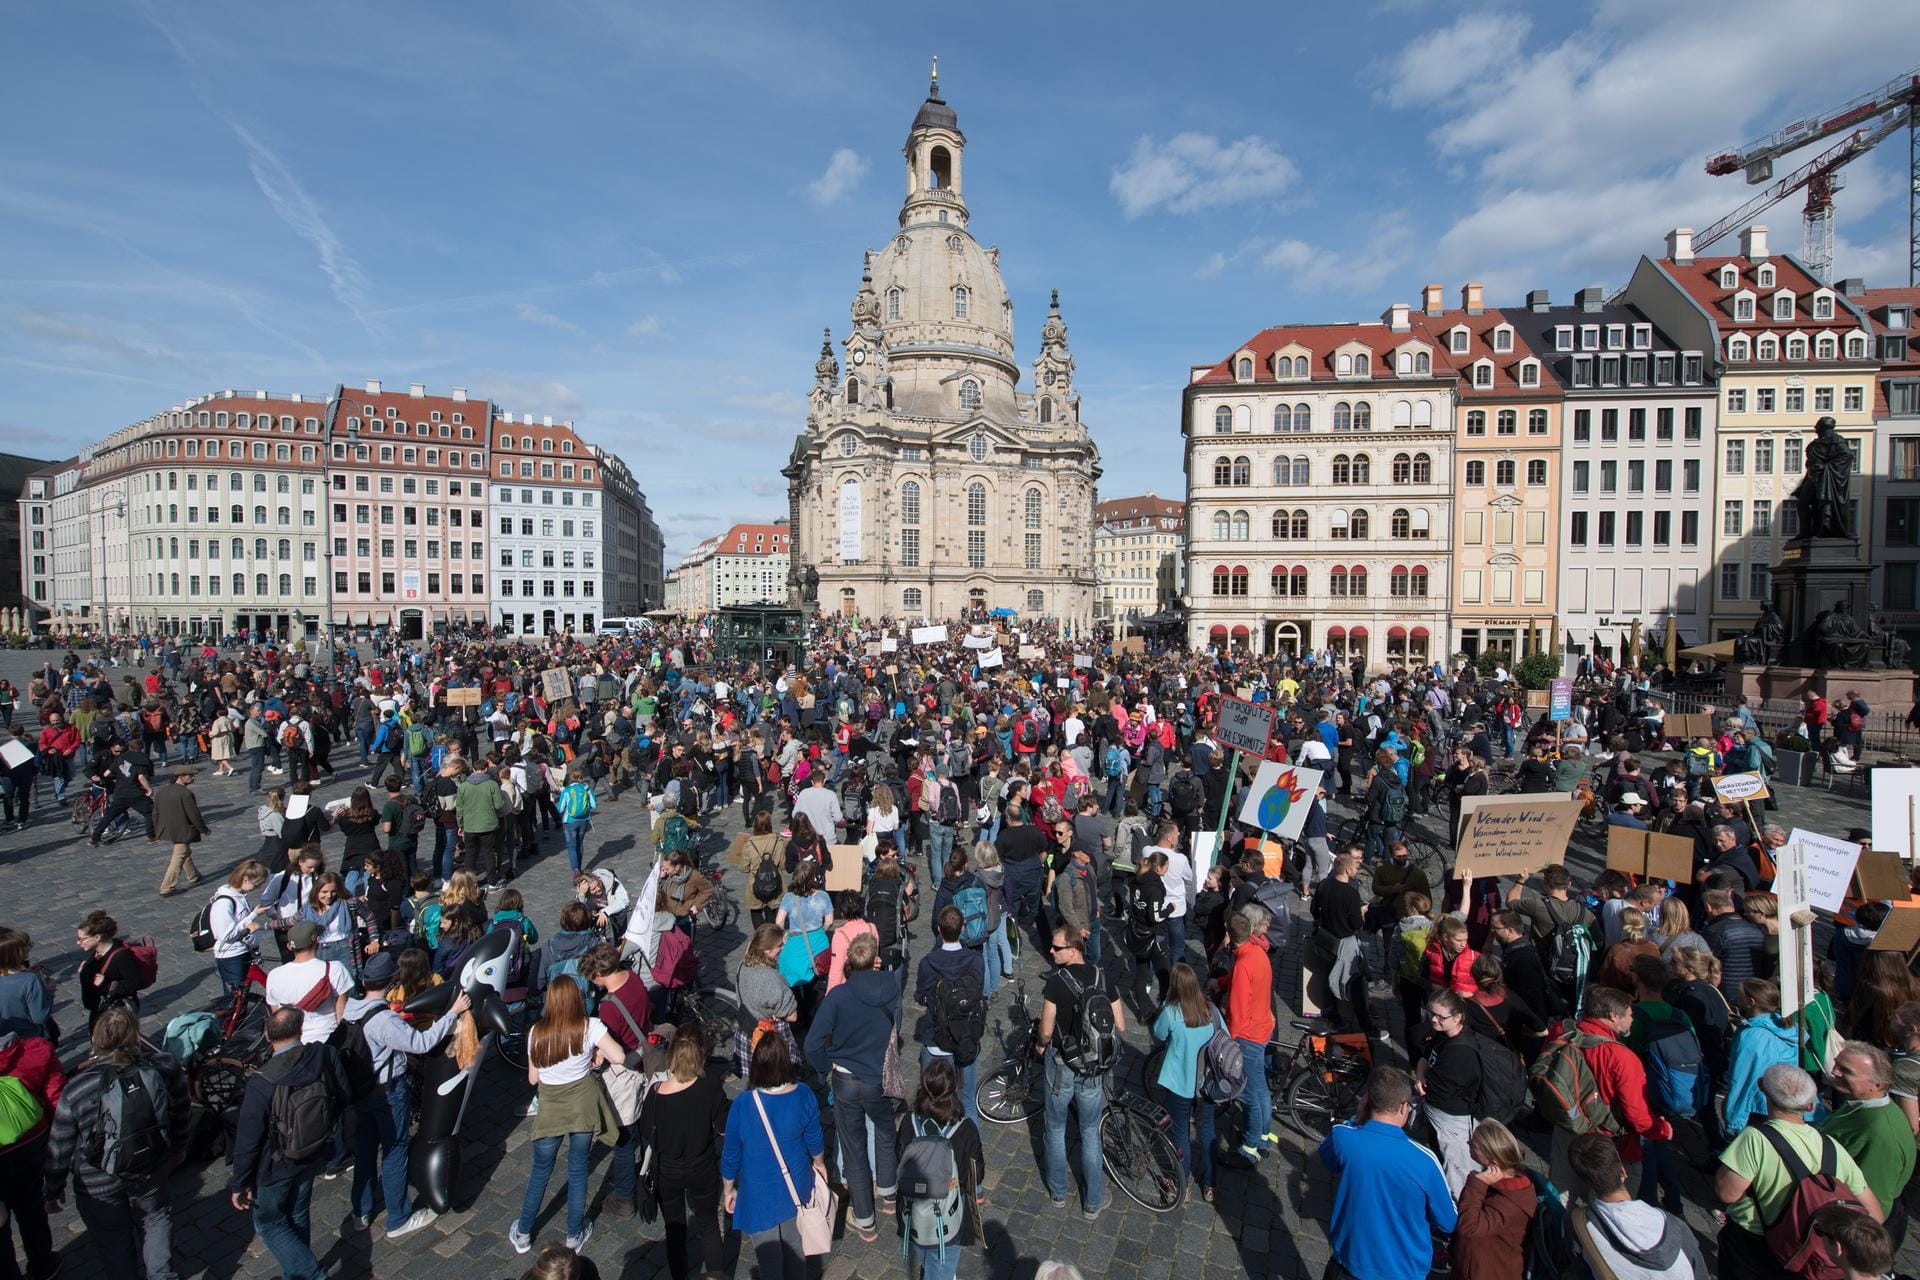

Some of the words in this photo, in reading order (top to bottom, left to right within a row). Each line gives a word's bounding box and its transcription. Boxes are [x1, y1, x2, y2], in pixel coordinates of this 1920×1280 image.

[1477, 811, 1502, 825] Wenn
[1519, 810, 1545, 823] Wind
[1799, 837, 1850, 857] Windenergie
[1808, 863, 1840, 877] aschutz
